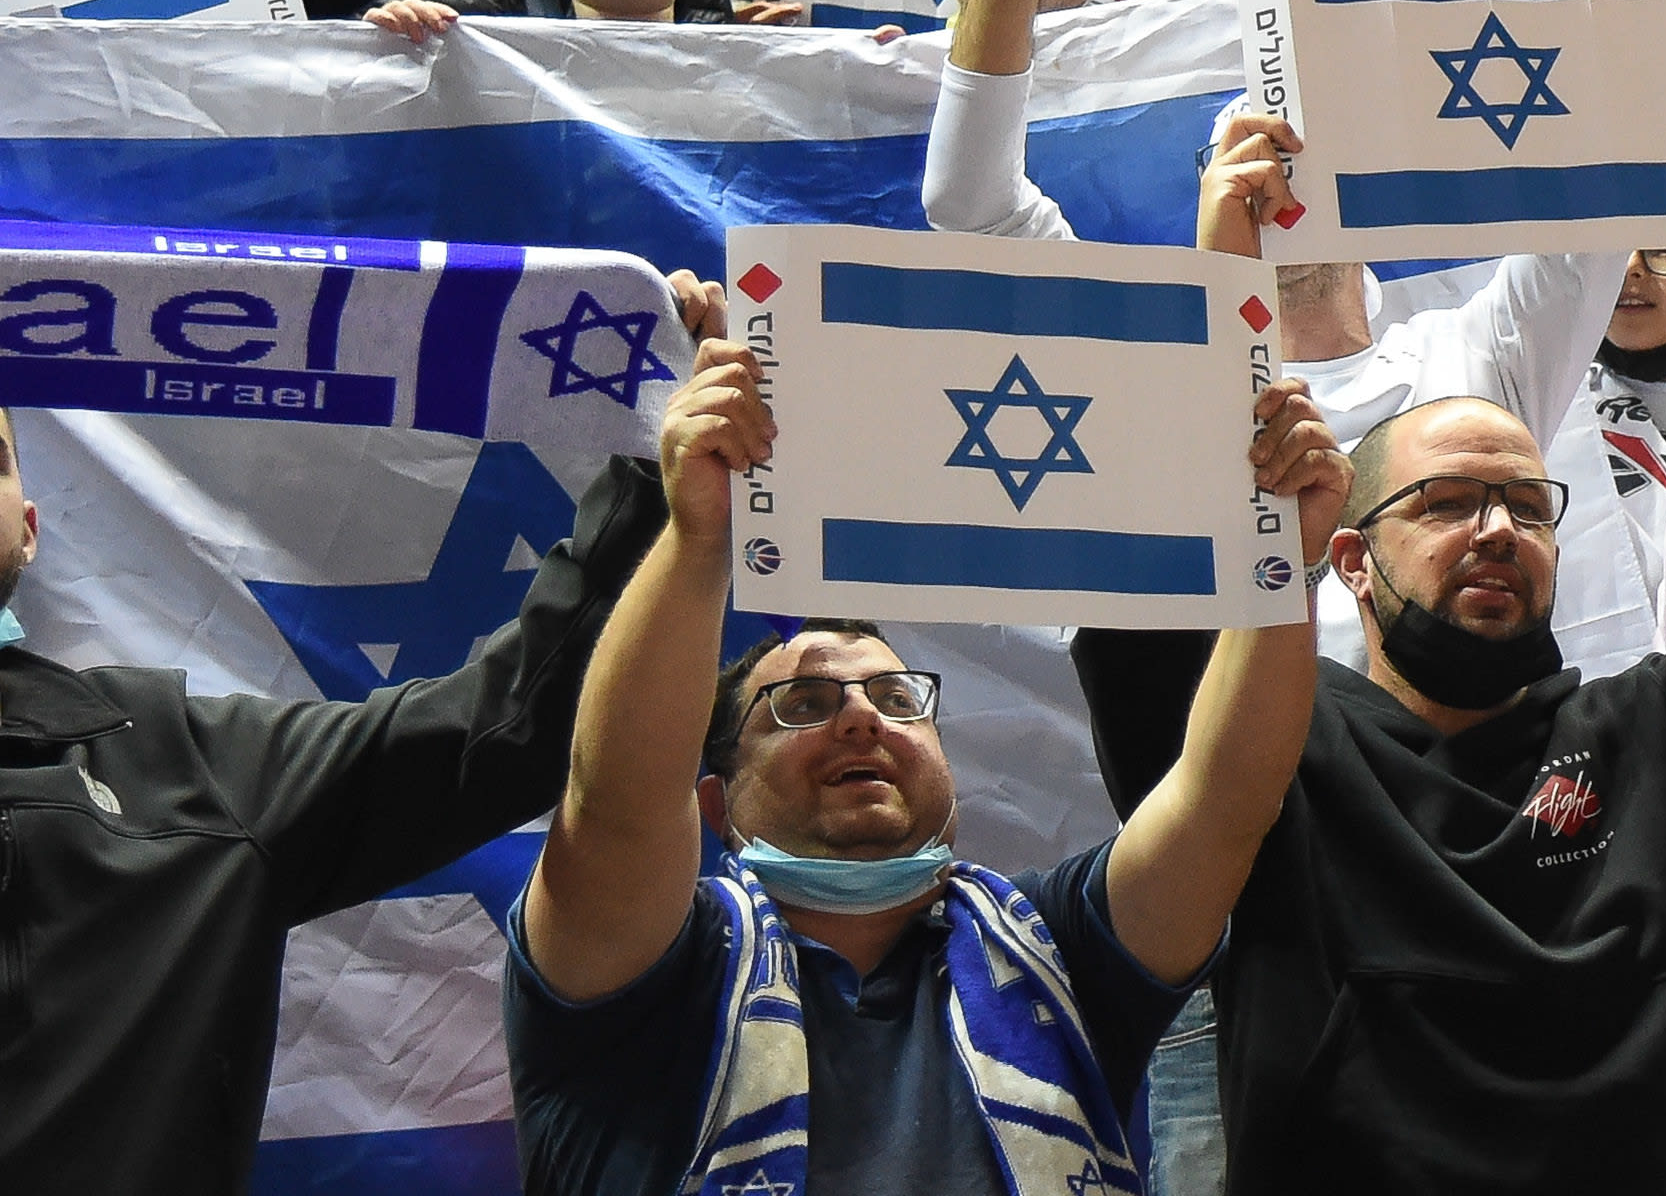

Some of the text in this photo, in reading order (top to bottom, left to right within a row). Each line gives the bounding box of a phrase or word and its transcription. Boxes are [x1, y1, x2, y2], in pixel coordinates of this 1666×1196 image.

[154, 235, 349, 262] Israel
[145, 368, 326, 410] Israel
[1535, 750, 1591, 780] ORDAN
[1522, 770, 1602, 840] Flight
